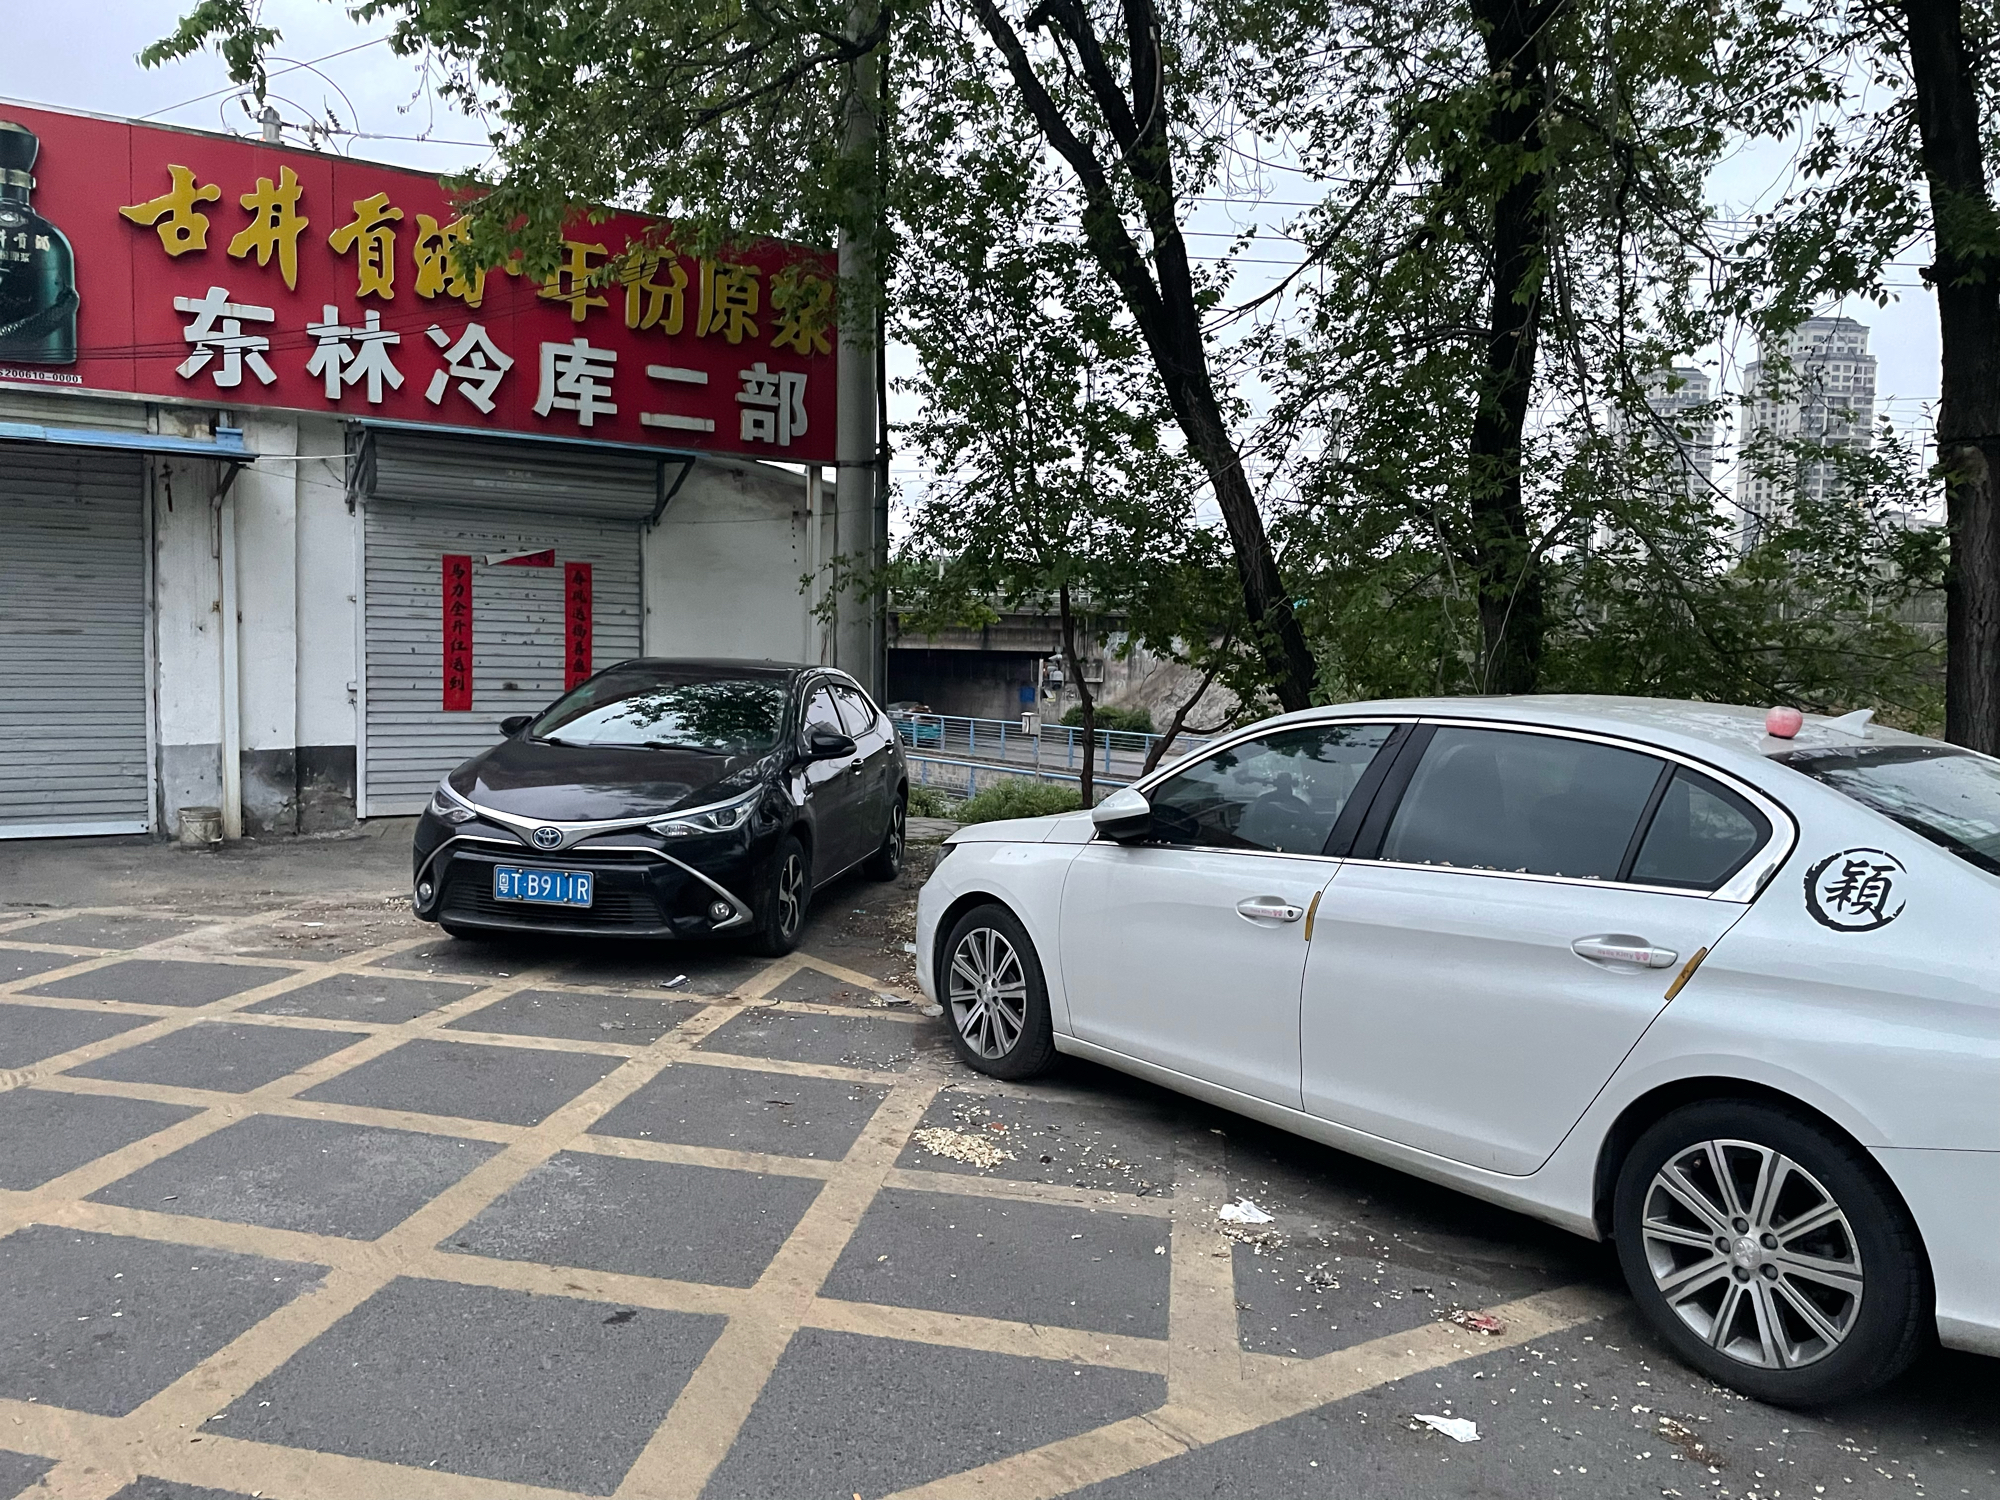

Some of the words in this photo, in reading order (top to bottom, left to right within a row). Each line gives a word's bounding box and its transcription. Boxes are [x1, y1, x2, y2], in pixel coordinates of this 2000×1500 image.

[173, 286, 809, 447] 东林冷库二部
